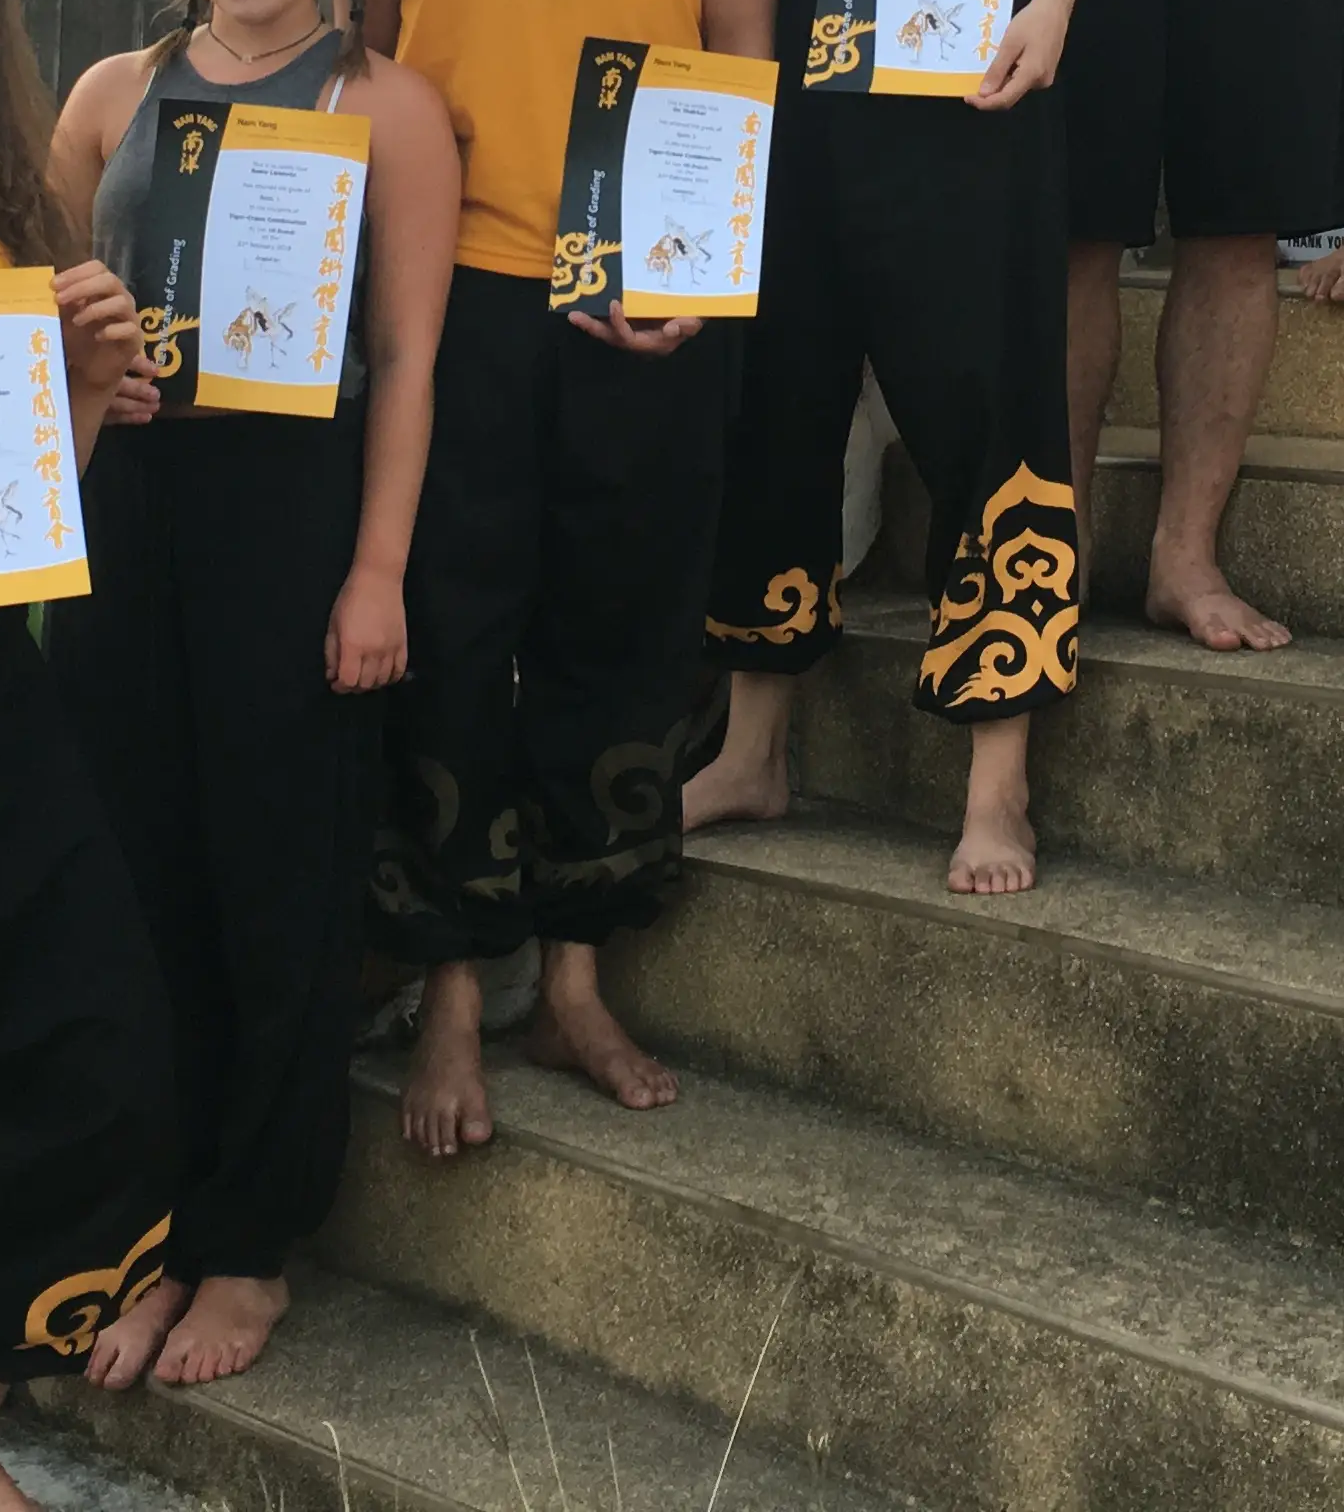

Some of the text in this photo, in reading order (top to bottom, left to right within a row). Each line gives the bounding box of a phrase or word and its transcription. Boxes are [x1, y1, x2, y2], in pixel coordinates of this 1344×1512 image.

[598, 67, 622, 110] 南洋
[173, 113, 218, 132] NAM YANG
[179, 130, 204, 175] 南洋
[166, 239, 186, 286] Grading
[164, 287, 175, 302] of
